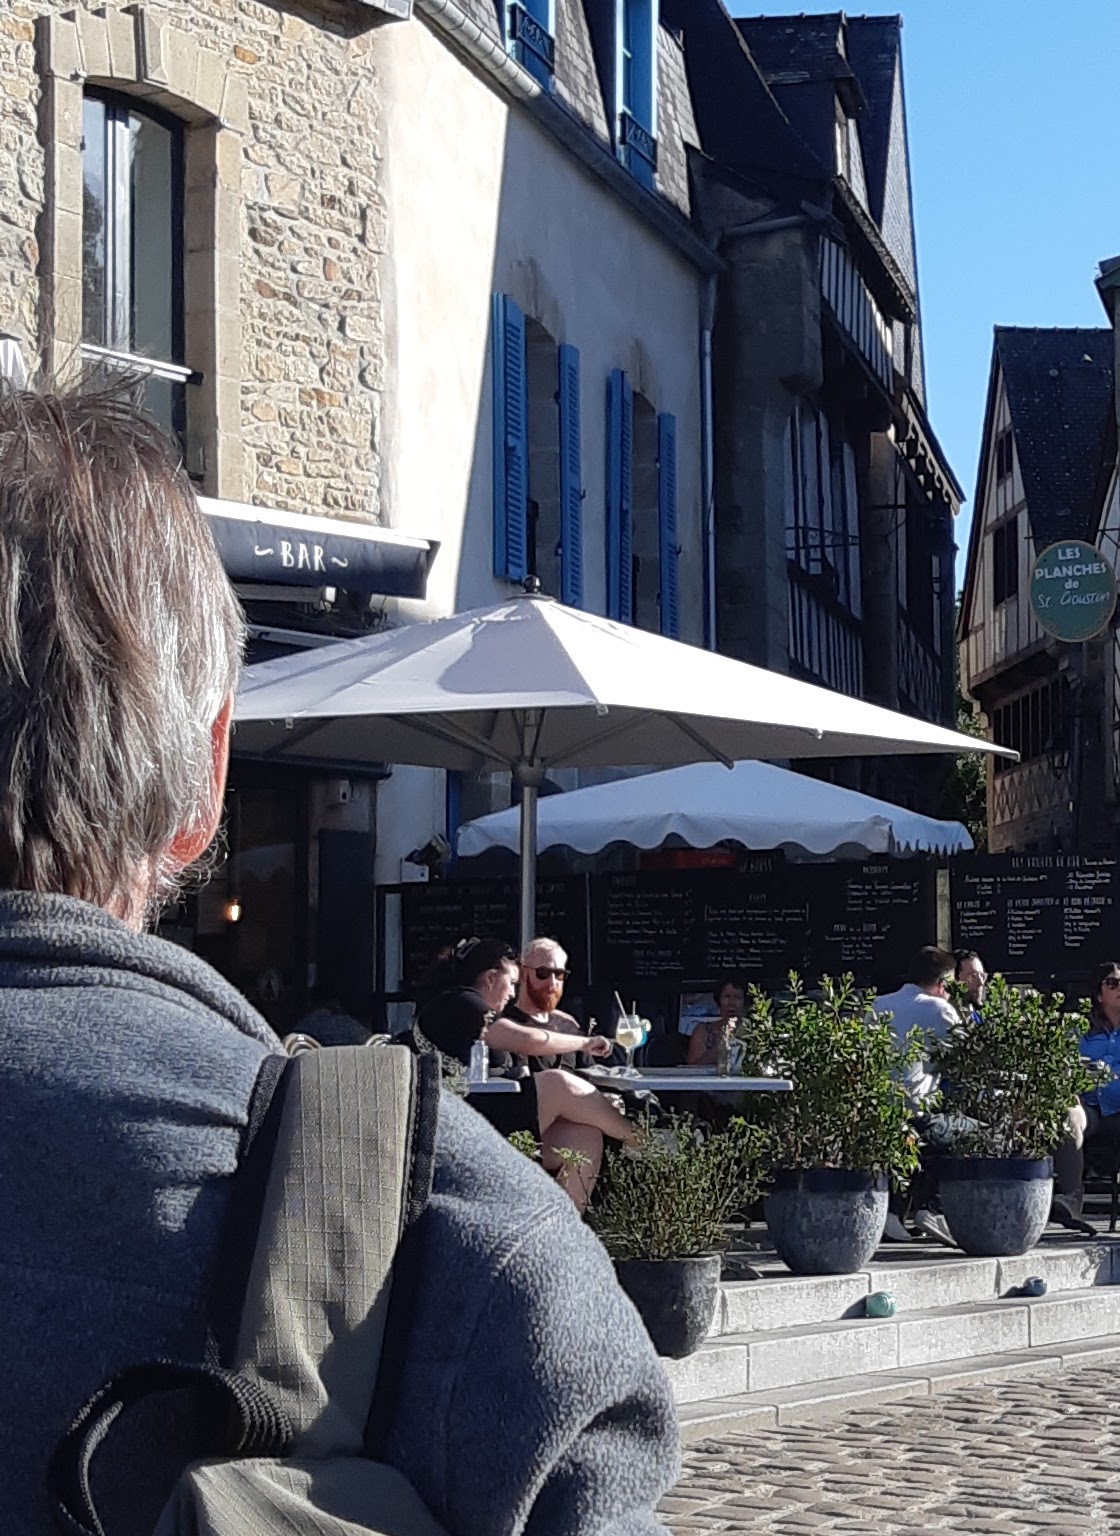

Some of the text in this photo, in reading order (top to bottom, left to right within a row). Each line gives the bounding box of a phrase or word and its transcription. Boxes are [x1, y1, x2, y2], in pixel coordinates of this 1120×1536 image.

[280, 540, 327, 572] BAR
[1058, 547, 1080, 560] LES
[1035, 563, 1107, 579] PLANCHES
[1065, 578, 1080, 589] de
